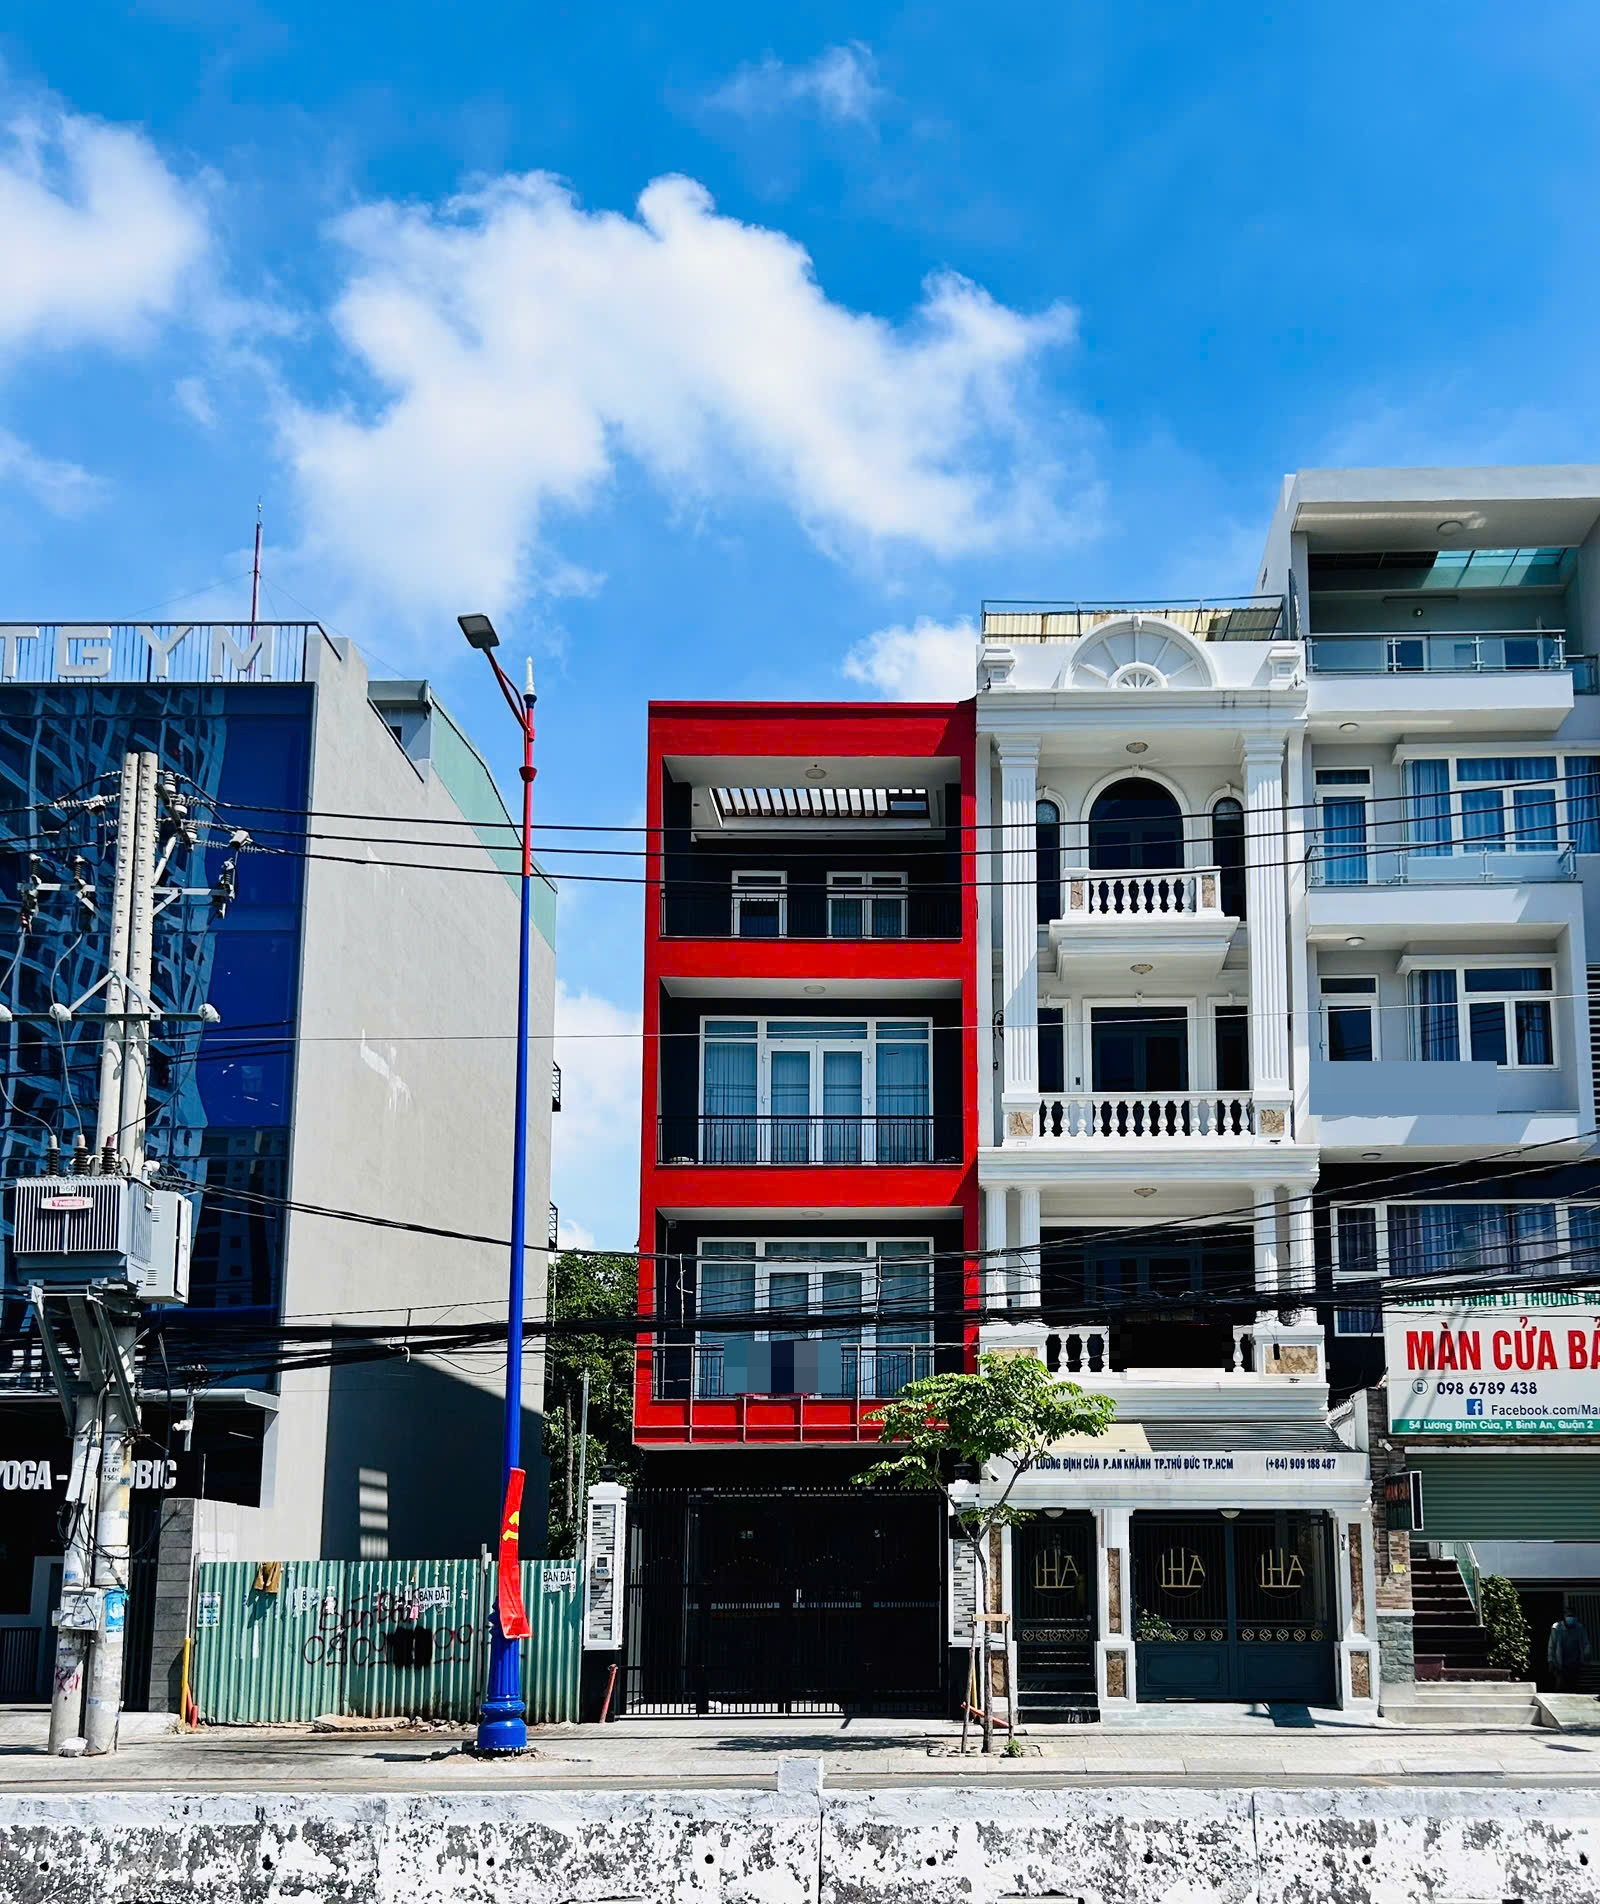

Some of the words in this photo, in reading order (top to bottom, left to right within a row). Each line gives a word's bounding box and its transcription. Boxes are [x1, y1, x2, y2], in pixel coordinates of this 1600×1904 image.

[1405, 1322, 1482, 1371] MÀN
[1492, 1315, 1558, 1371] CỬA
[1436, 1382, 1464, 1395] 098
[1468, 1382, 1506, 1395] 6789
[1510, 1382, 1538, 1395] 438
[1491, 1404, 1600, 1416] Facebook.com/Ma
[1408, 1420, 1421, 1430] 54
[1423, 1420, 1452, 1432] Lương
[1455, 1420, 1477, 1432] Định
[1505, 1420, 1514, 1430] P.
[1516, 1419, 1537, 1430] Bình
[1538, 1420, 1556, 1431] An,
[1558, 1419, 1584, 1432] Quận
[1586, 1420, 1594, 1430] 2
[1063, 1457, 1082, 1472] ĐỊNH
[1084, 1454, 1100, 1470] CỦA
[1124, 1456, 1151, 1470] KHÁNH
[1183, 1455, 1201, 1470] ĐỨC
[1202, 1458, 1234, 1470] TP.HCM
[1265, 1457, 1288, 1470] (+84)
[1289, 1458, 1306, 1470] 909
[1321, 1458, 1337, 1470] 487
